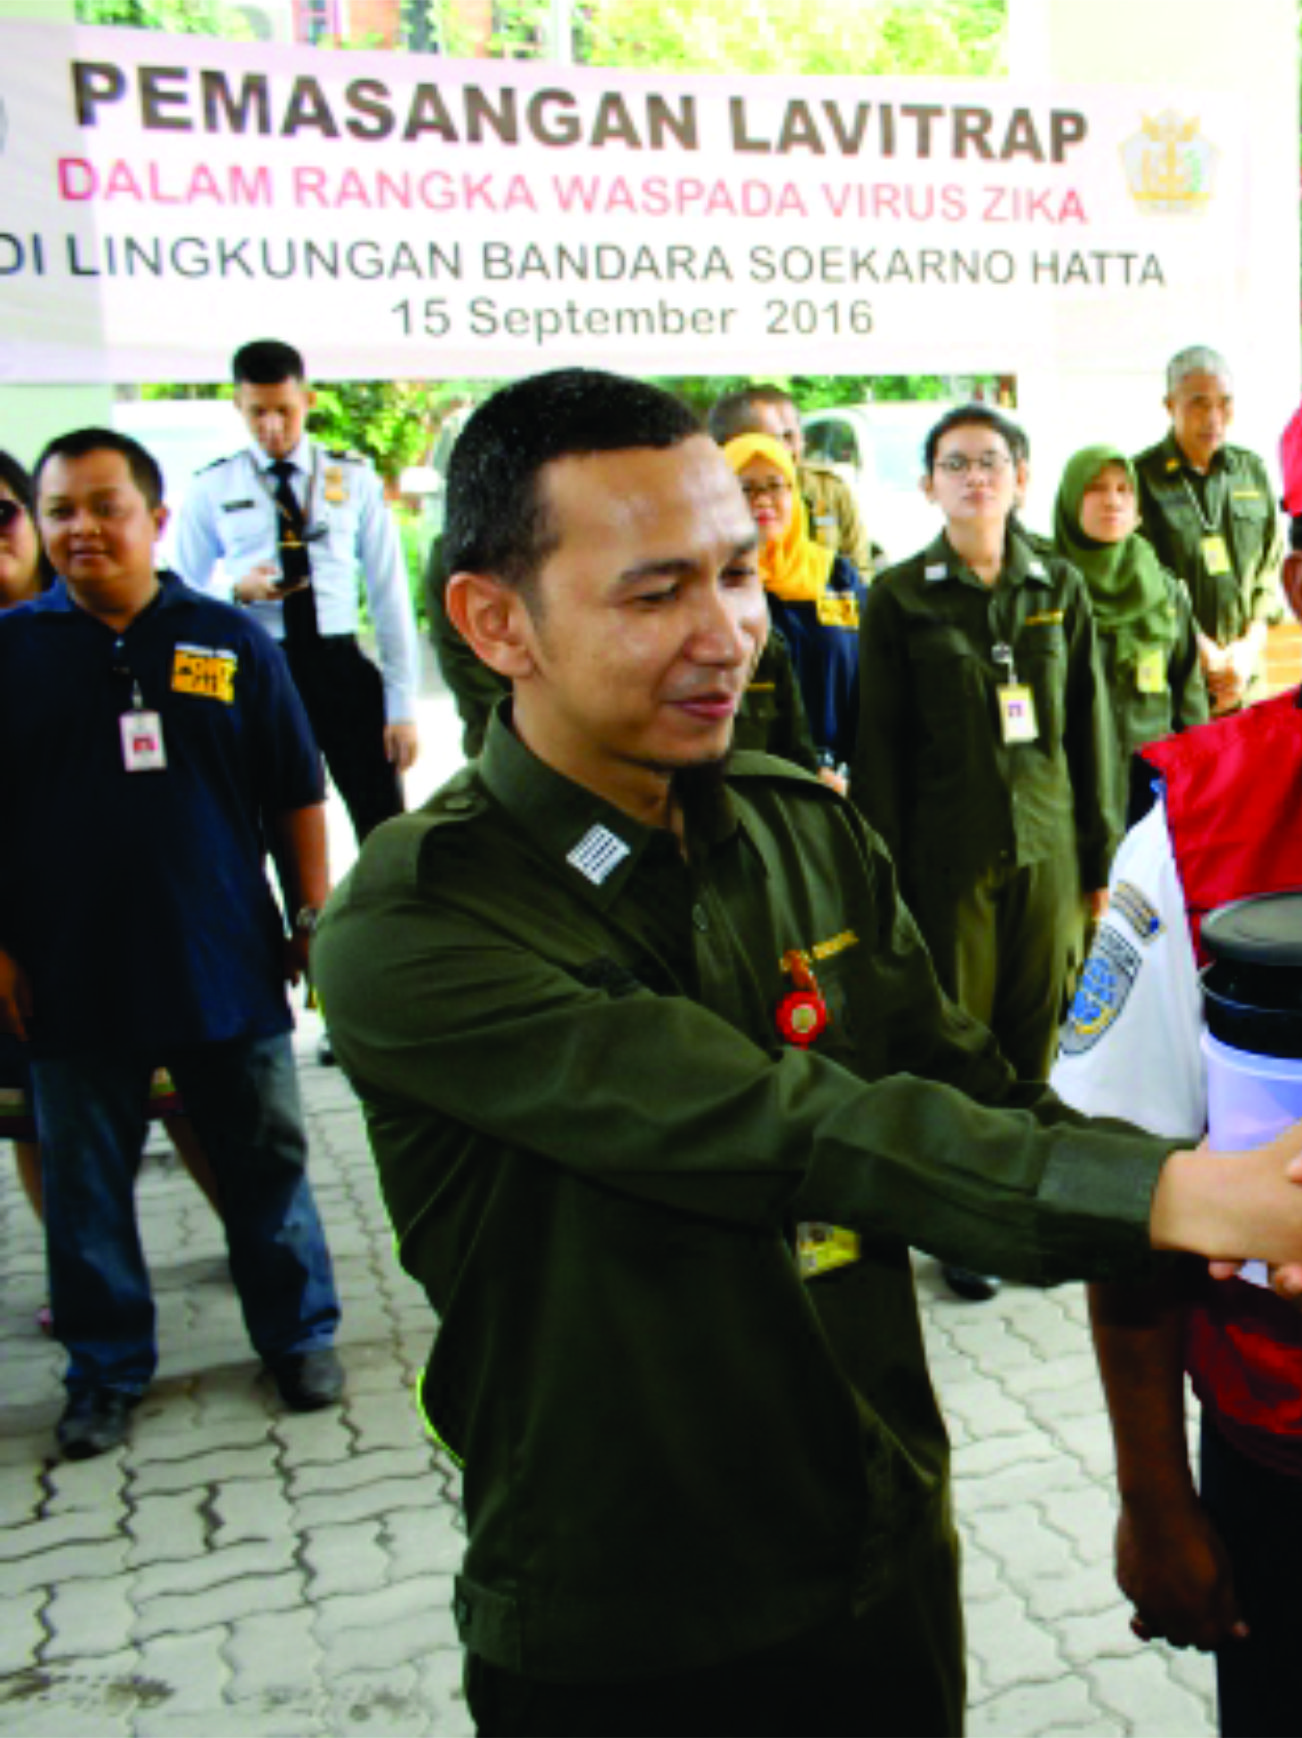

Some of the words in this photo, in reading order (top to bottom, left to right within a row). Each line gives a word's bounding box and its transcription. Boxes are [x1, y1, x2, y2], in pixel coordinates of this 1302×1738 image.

[70, 61, 698, 151] PEMASANGAN
[729, 96, 1088, 164] LAVITRAP
[57, 157, 273, 207] DALAM
[292, 166, 538, 212] RANGKA
[552, 174, 808, 217] WASPADA
[820, 182, 967, 223] VIRUS
[982, 186, 1089, 225] ZIKA
[0, 232, 45, 276] DI
[65, 233, 462, 280] LINGKUNGAN
[482, 241, 733, 281] BANDARA
[749, 245, 1016, 284] SOEKARNO
[1032, 250, 1166, 287] HATTA
[392, 297, 451, 338] 15
[467, 296, 736, 346] September
[765, 299, 874, 336] 2016
